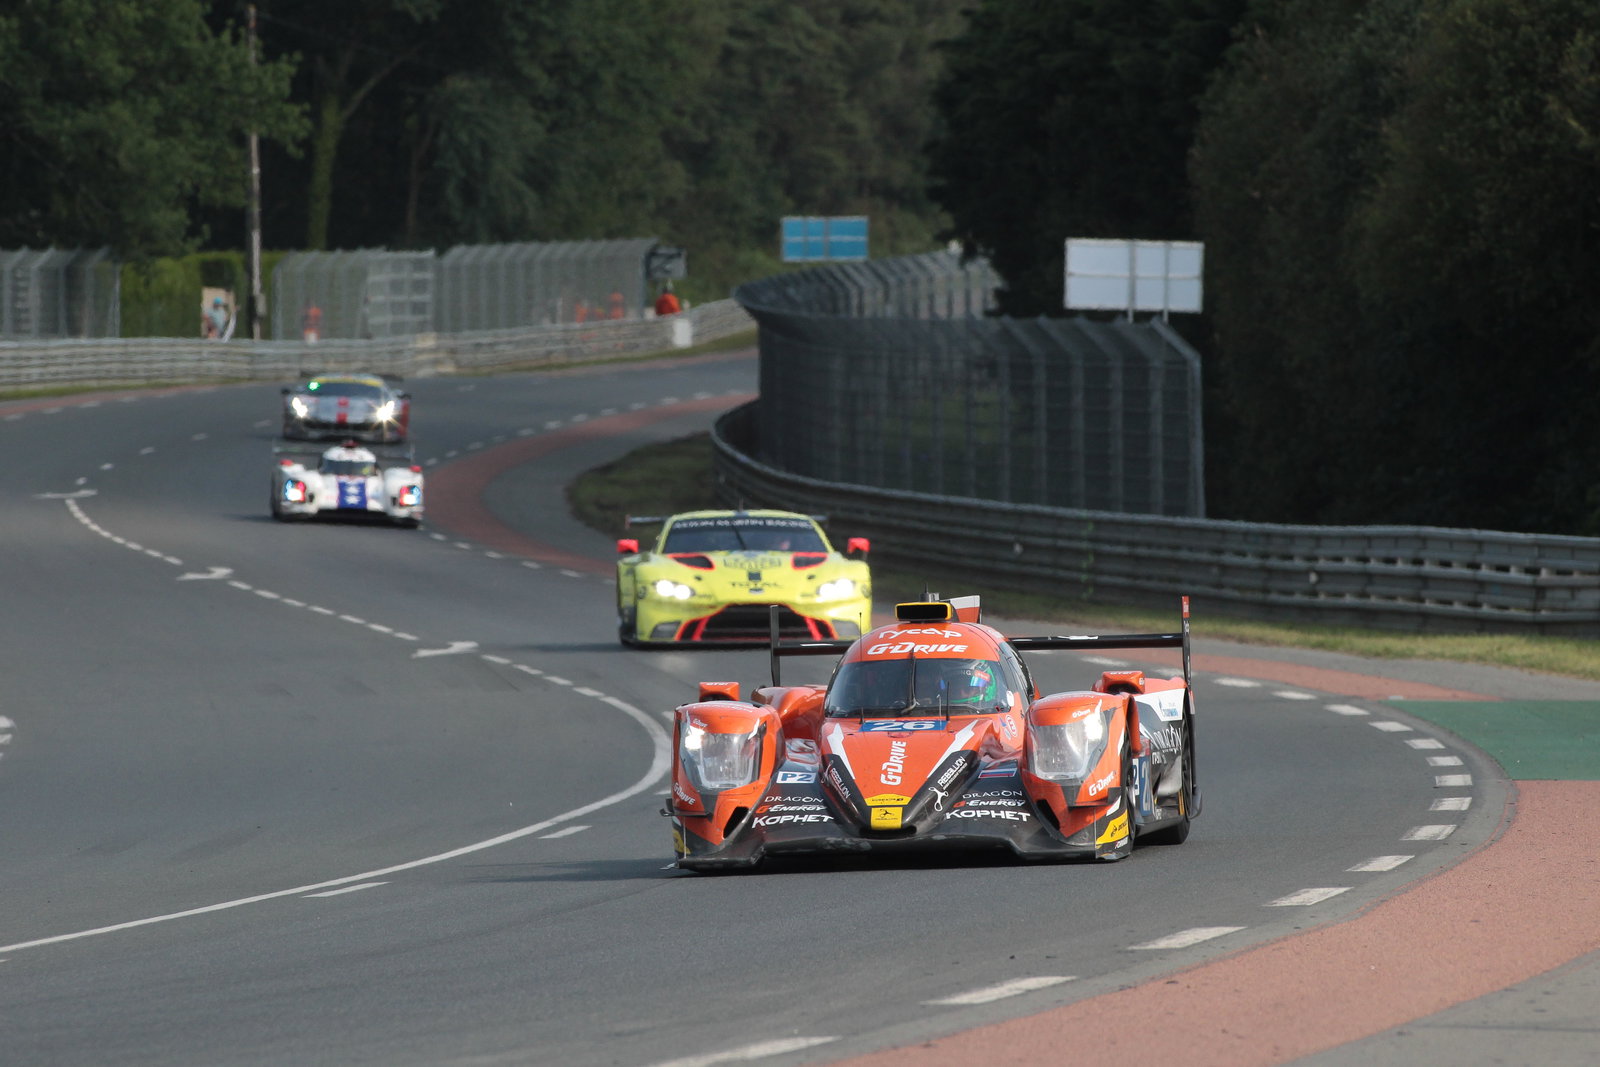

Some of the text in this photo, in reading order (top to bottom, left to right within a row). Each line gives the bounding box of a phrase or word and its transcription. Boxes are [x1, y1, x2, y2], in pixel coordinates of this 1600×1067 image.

[869, 721, 936, 731] 26
[780, 773, 813, 782] P2
[962, 790, 1023, 799] DRAGON
